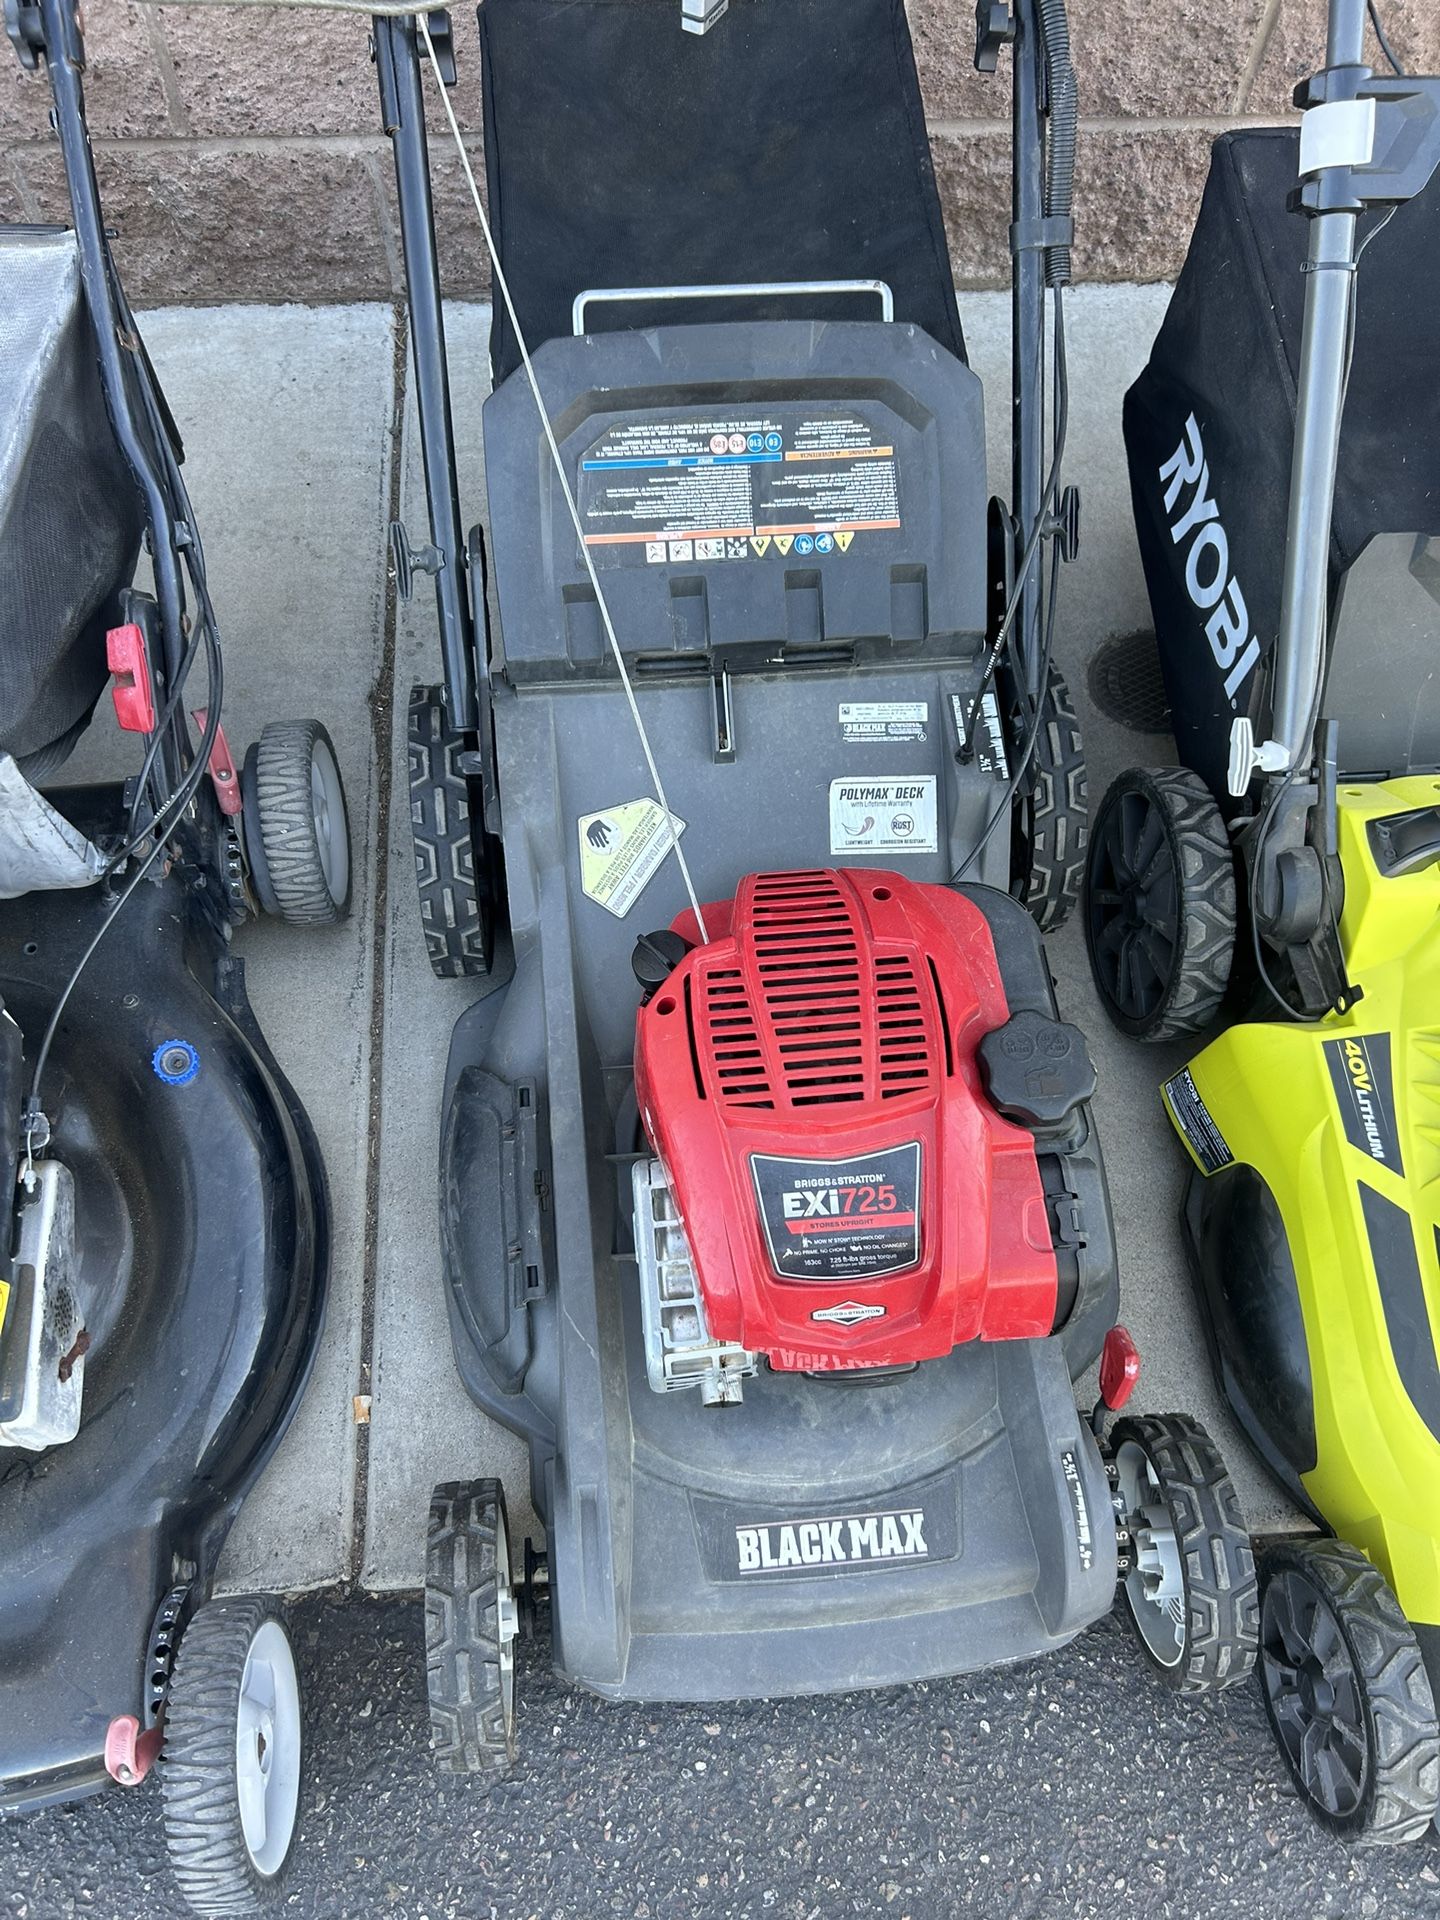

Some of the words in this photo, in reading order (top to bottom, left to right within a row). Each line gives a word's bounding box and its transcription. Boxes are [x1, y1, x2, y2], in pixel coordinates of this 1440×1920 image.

[749, 438, 763, 448] E10
[1159, 411, 1261, 700] RYOBI
[895, 786, 925, 799] DECK
[888, 800, 913, 808] Warranty
[645, 822, 657, 836] KEEP
[892, 821, 911, 831] RUST
[633, 835, 648, 854] HANDS
[618, 862, 629, 876] FEET
[607, 875, 621, 891] AWAY
[1182, 1070, 1199, 1105] RYOBI
[1354, 1089, 1385, 1160] LITHIUM
[810, 1222, 841, 1230] STORES
[841, 1218, 874, 1227] UPRIGHT
[851, 1234, 885, 1243] TECHNOLOGY
[842, 1255, 859, 1263] ft-lbs
[859, 1255, 877, 1263] gross
[877, 1253, 898, 1261] torque
[1105, 1464, 1117, 1476] 3
[1113, 1498, 1125, 1510] 4
[736, 1521, 847, 1571] BLACK
[848, 1513, 928, 1560] MAX
[1116, 1531, 1129, 1541] 5
[1117, 1560, 1129, 1568] 6
